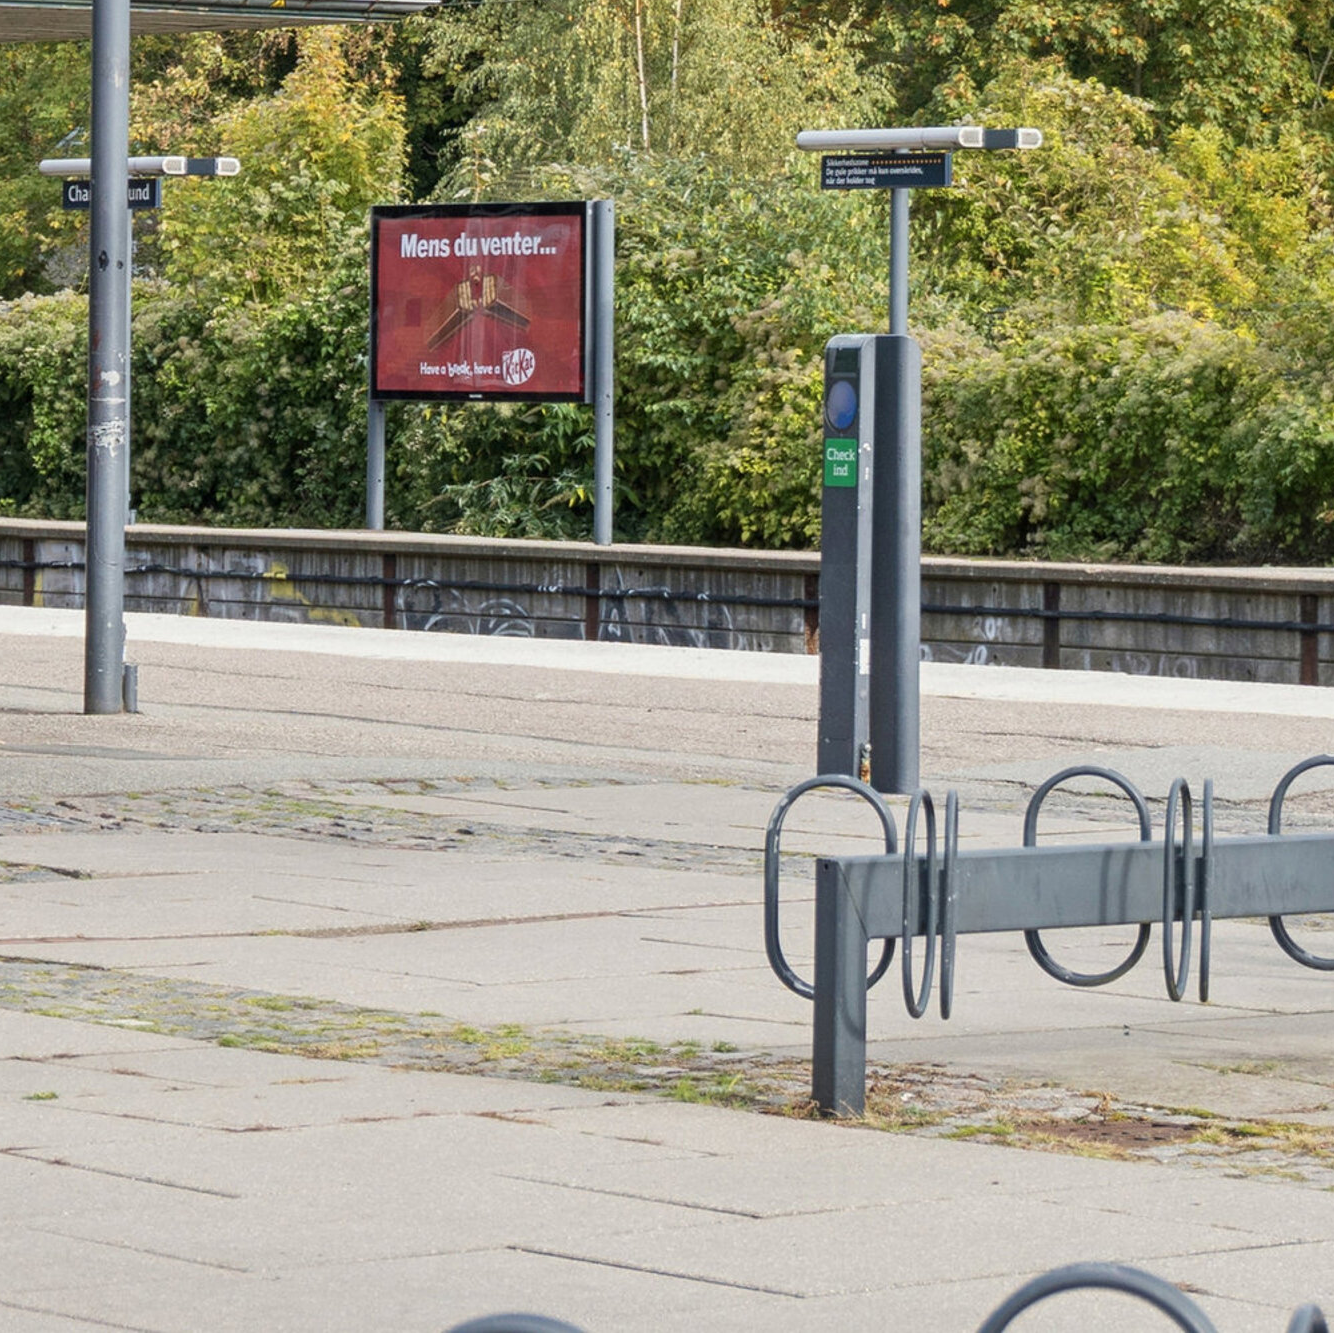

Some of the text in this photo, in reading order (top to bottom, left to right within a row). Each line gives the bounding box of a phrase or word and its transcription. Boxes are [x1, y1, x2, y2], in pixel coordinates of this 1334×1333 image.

[401, 231, 557, 258] Mens du venter...
[419, 361, 440, 375] Have
[440, 365, 447, 375] a
[473, 361, 493, 375] have
[494, 365, 500, 375] a
[826, 447, 855, 462] Check
[833, 464, 849, 476] ind
